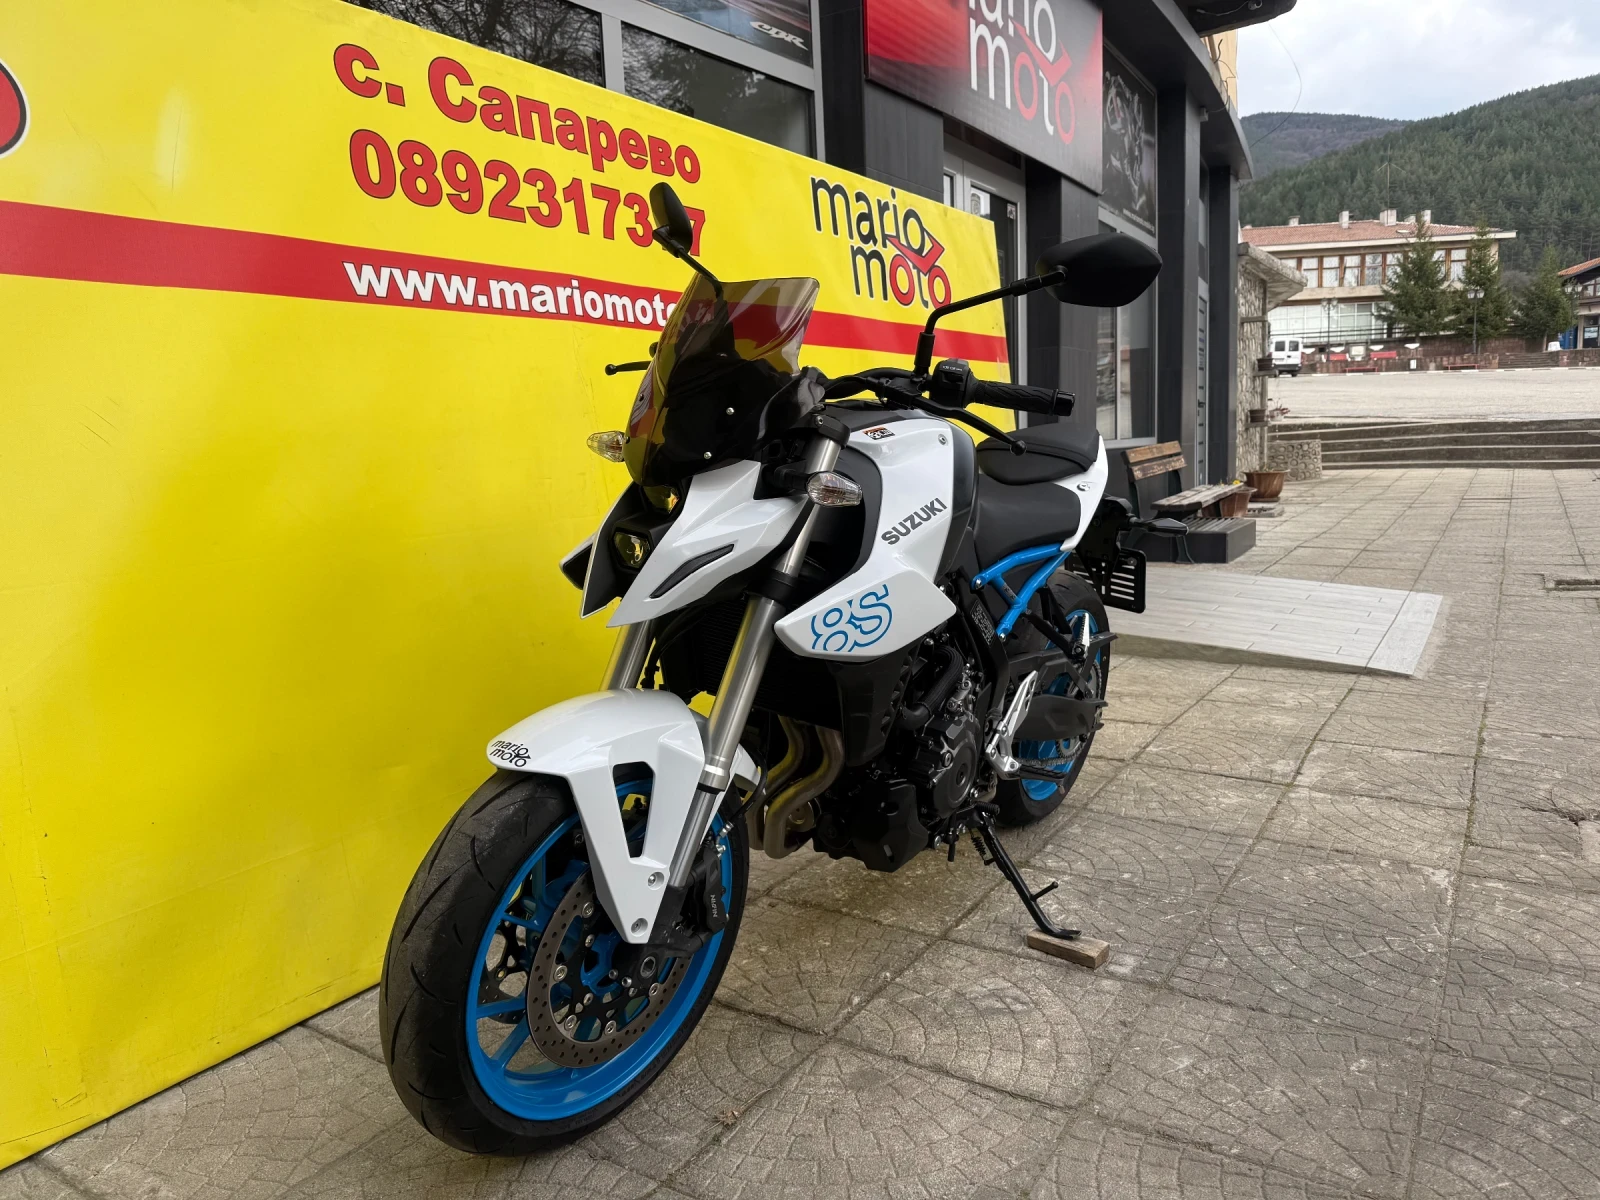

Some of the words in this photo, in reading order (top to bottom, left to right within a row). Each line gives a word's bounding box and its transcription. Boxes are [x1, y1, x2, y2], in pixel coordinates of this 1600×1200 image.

[969, 17, 1076, 145] moto
[428, 56, 701, 183] Сапарево
[349, 129, 706, 257] 089231737
[810, 176, 928, 256] mario
[850, 243, 952, 310] moto
[881, 498, 947, 545] SUZUKI
[489, 748, 527, 768] moto
[490, 740, 529, 756] mario
